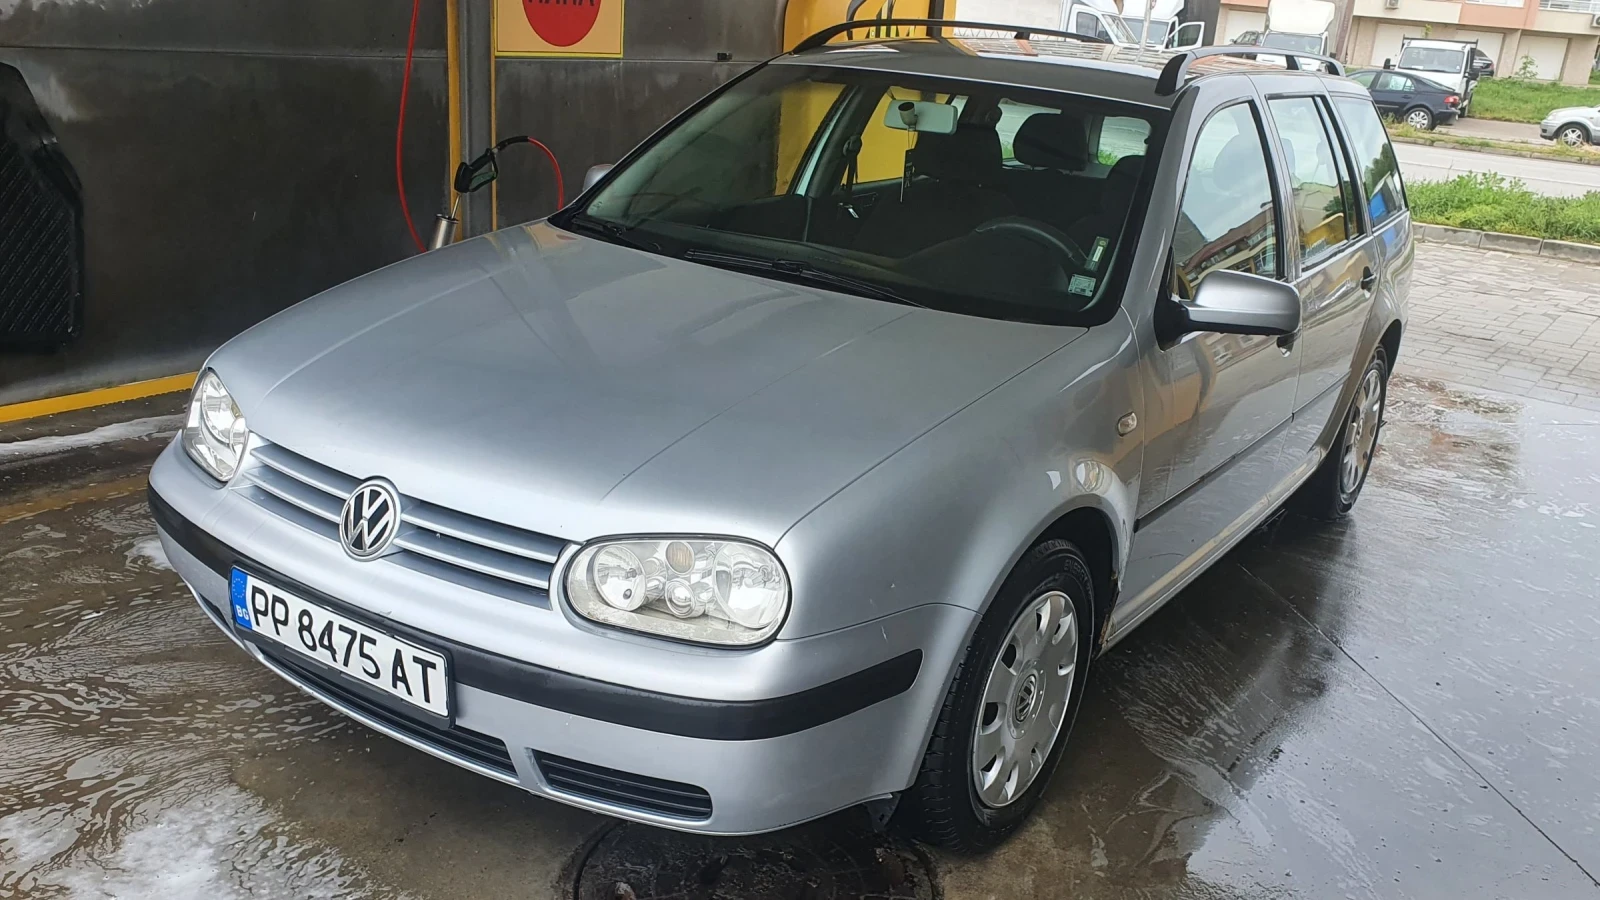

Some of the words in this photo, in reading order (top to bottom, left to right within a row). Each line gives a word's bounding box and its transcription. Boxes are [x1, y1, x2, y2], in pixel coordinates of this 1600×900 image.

[342, 483, 397, 556] VW
[235, 604, 250, 621] BG
[251, 585, 290, 636] PP
[297, 608, 382, 680] 8475
[391, 648, 437, 704] AT
